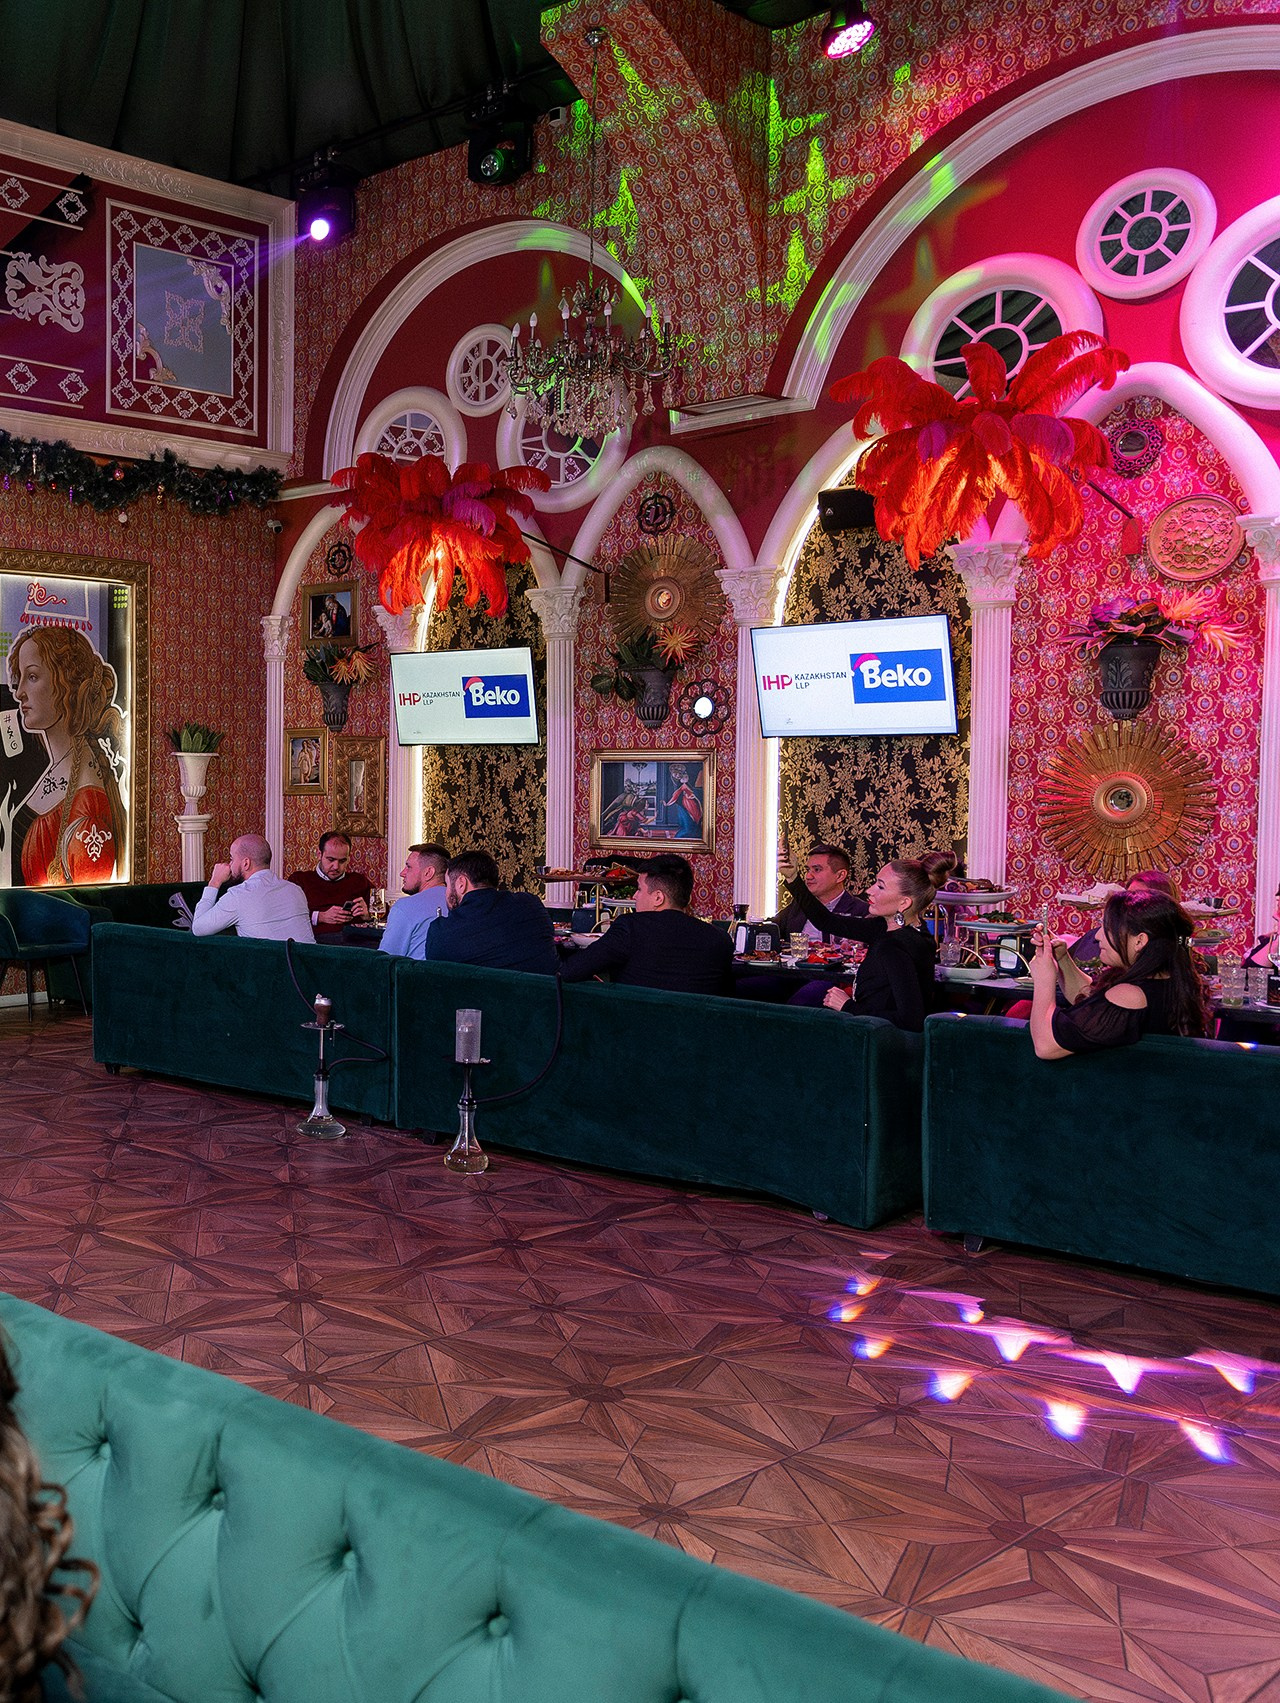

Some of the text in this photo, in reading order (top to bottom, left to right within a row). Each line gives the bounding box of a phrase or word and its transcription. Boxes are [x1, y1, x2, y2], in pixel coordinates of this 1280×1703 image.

[762, 674, 792, 690] IHP
[795, 672, 847, 680] KAZAKHSTAN
[863, 664, 932, 689] Beko
[399, 693, 421, 706] IHP
[472, 686, 520, 706] Beko
